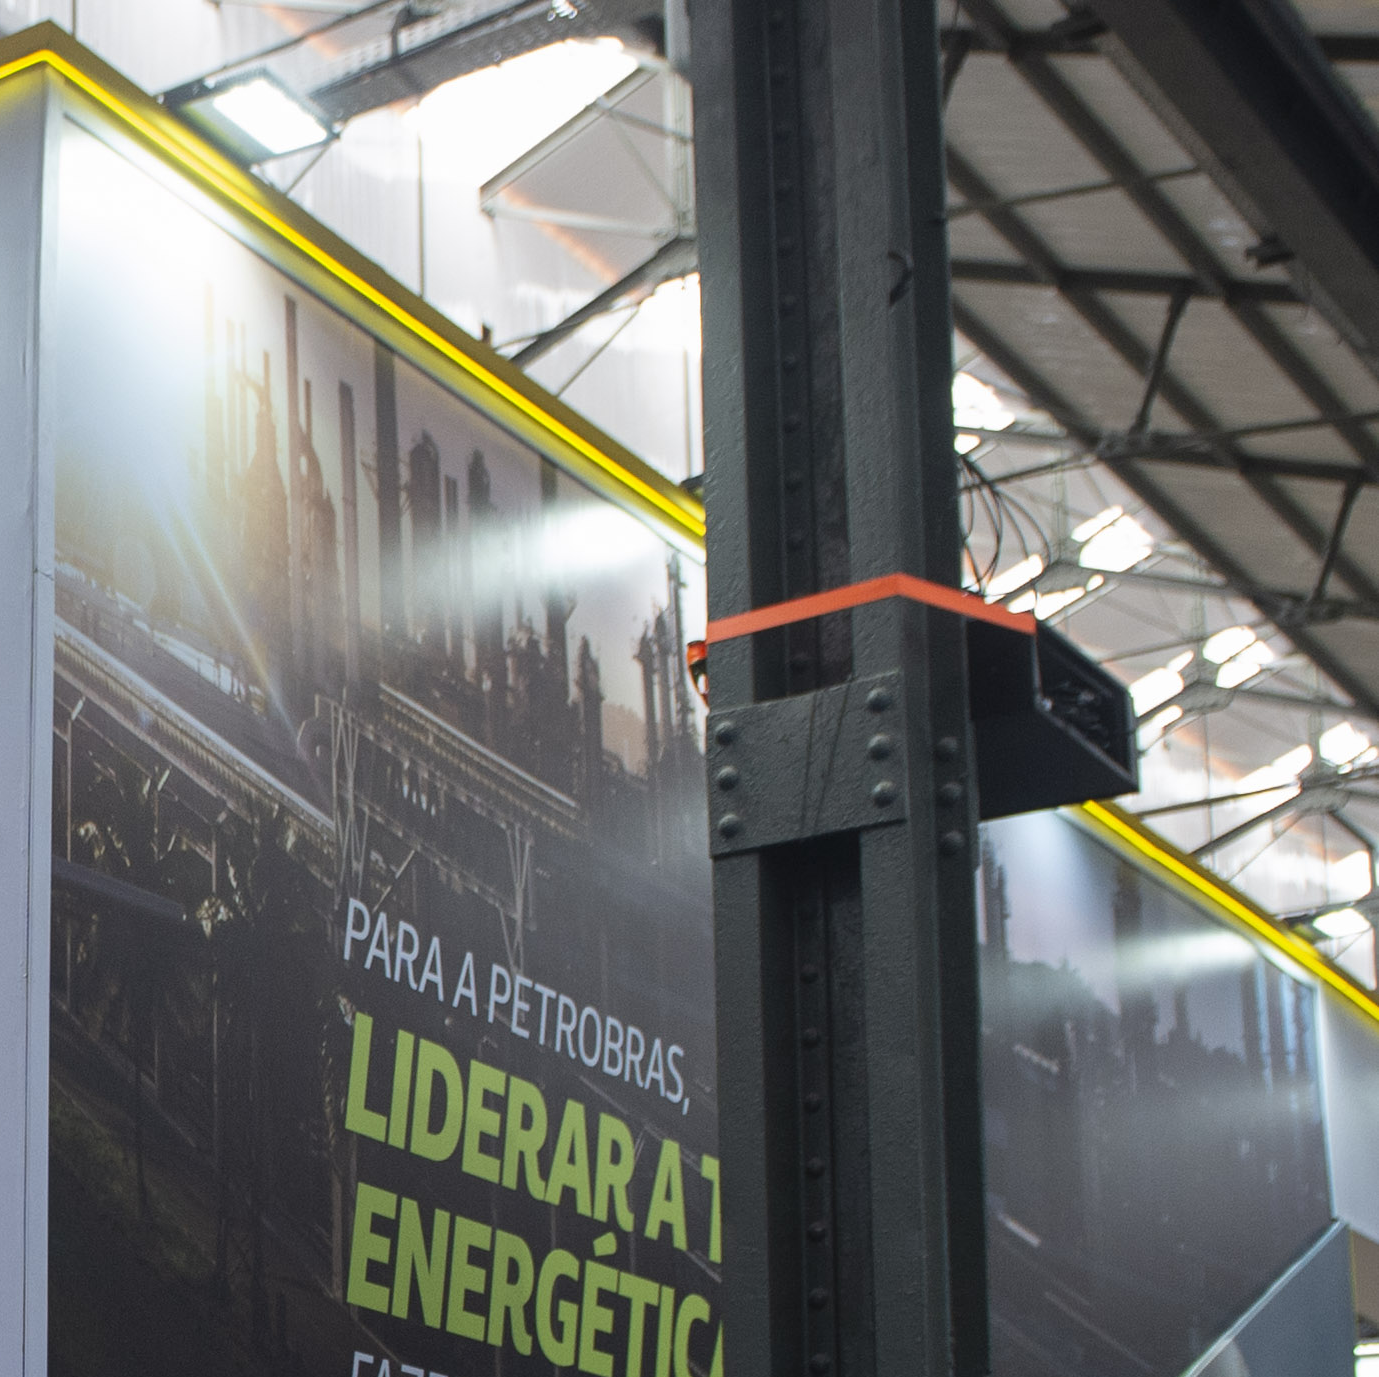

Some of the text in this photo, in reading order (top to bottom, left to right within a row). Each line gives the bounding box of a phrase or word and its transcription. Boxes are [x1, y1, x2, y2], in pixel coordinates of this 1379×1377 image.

[344, 898, 690, 1115] PARA A PETROBRAS,
[344, 1011, 635, 1233] LIDERAR
[644, 1138, 688, 1251] A
